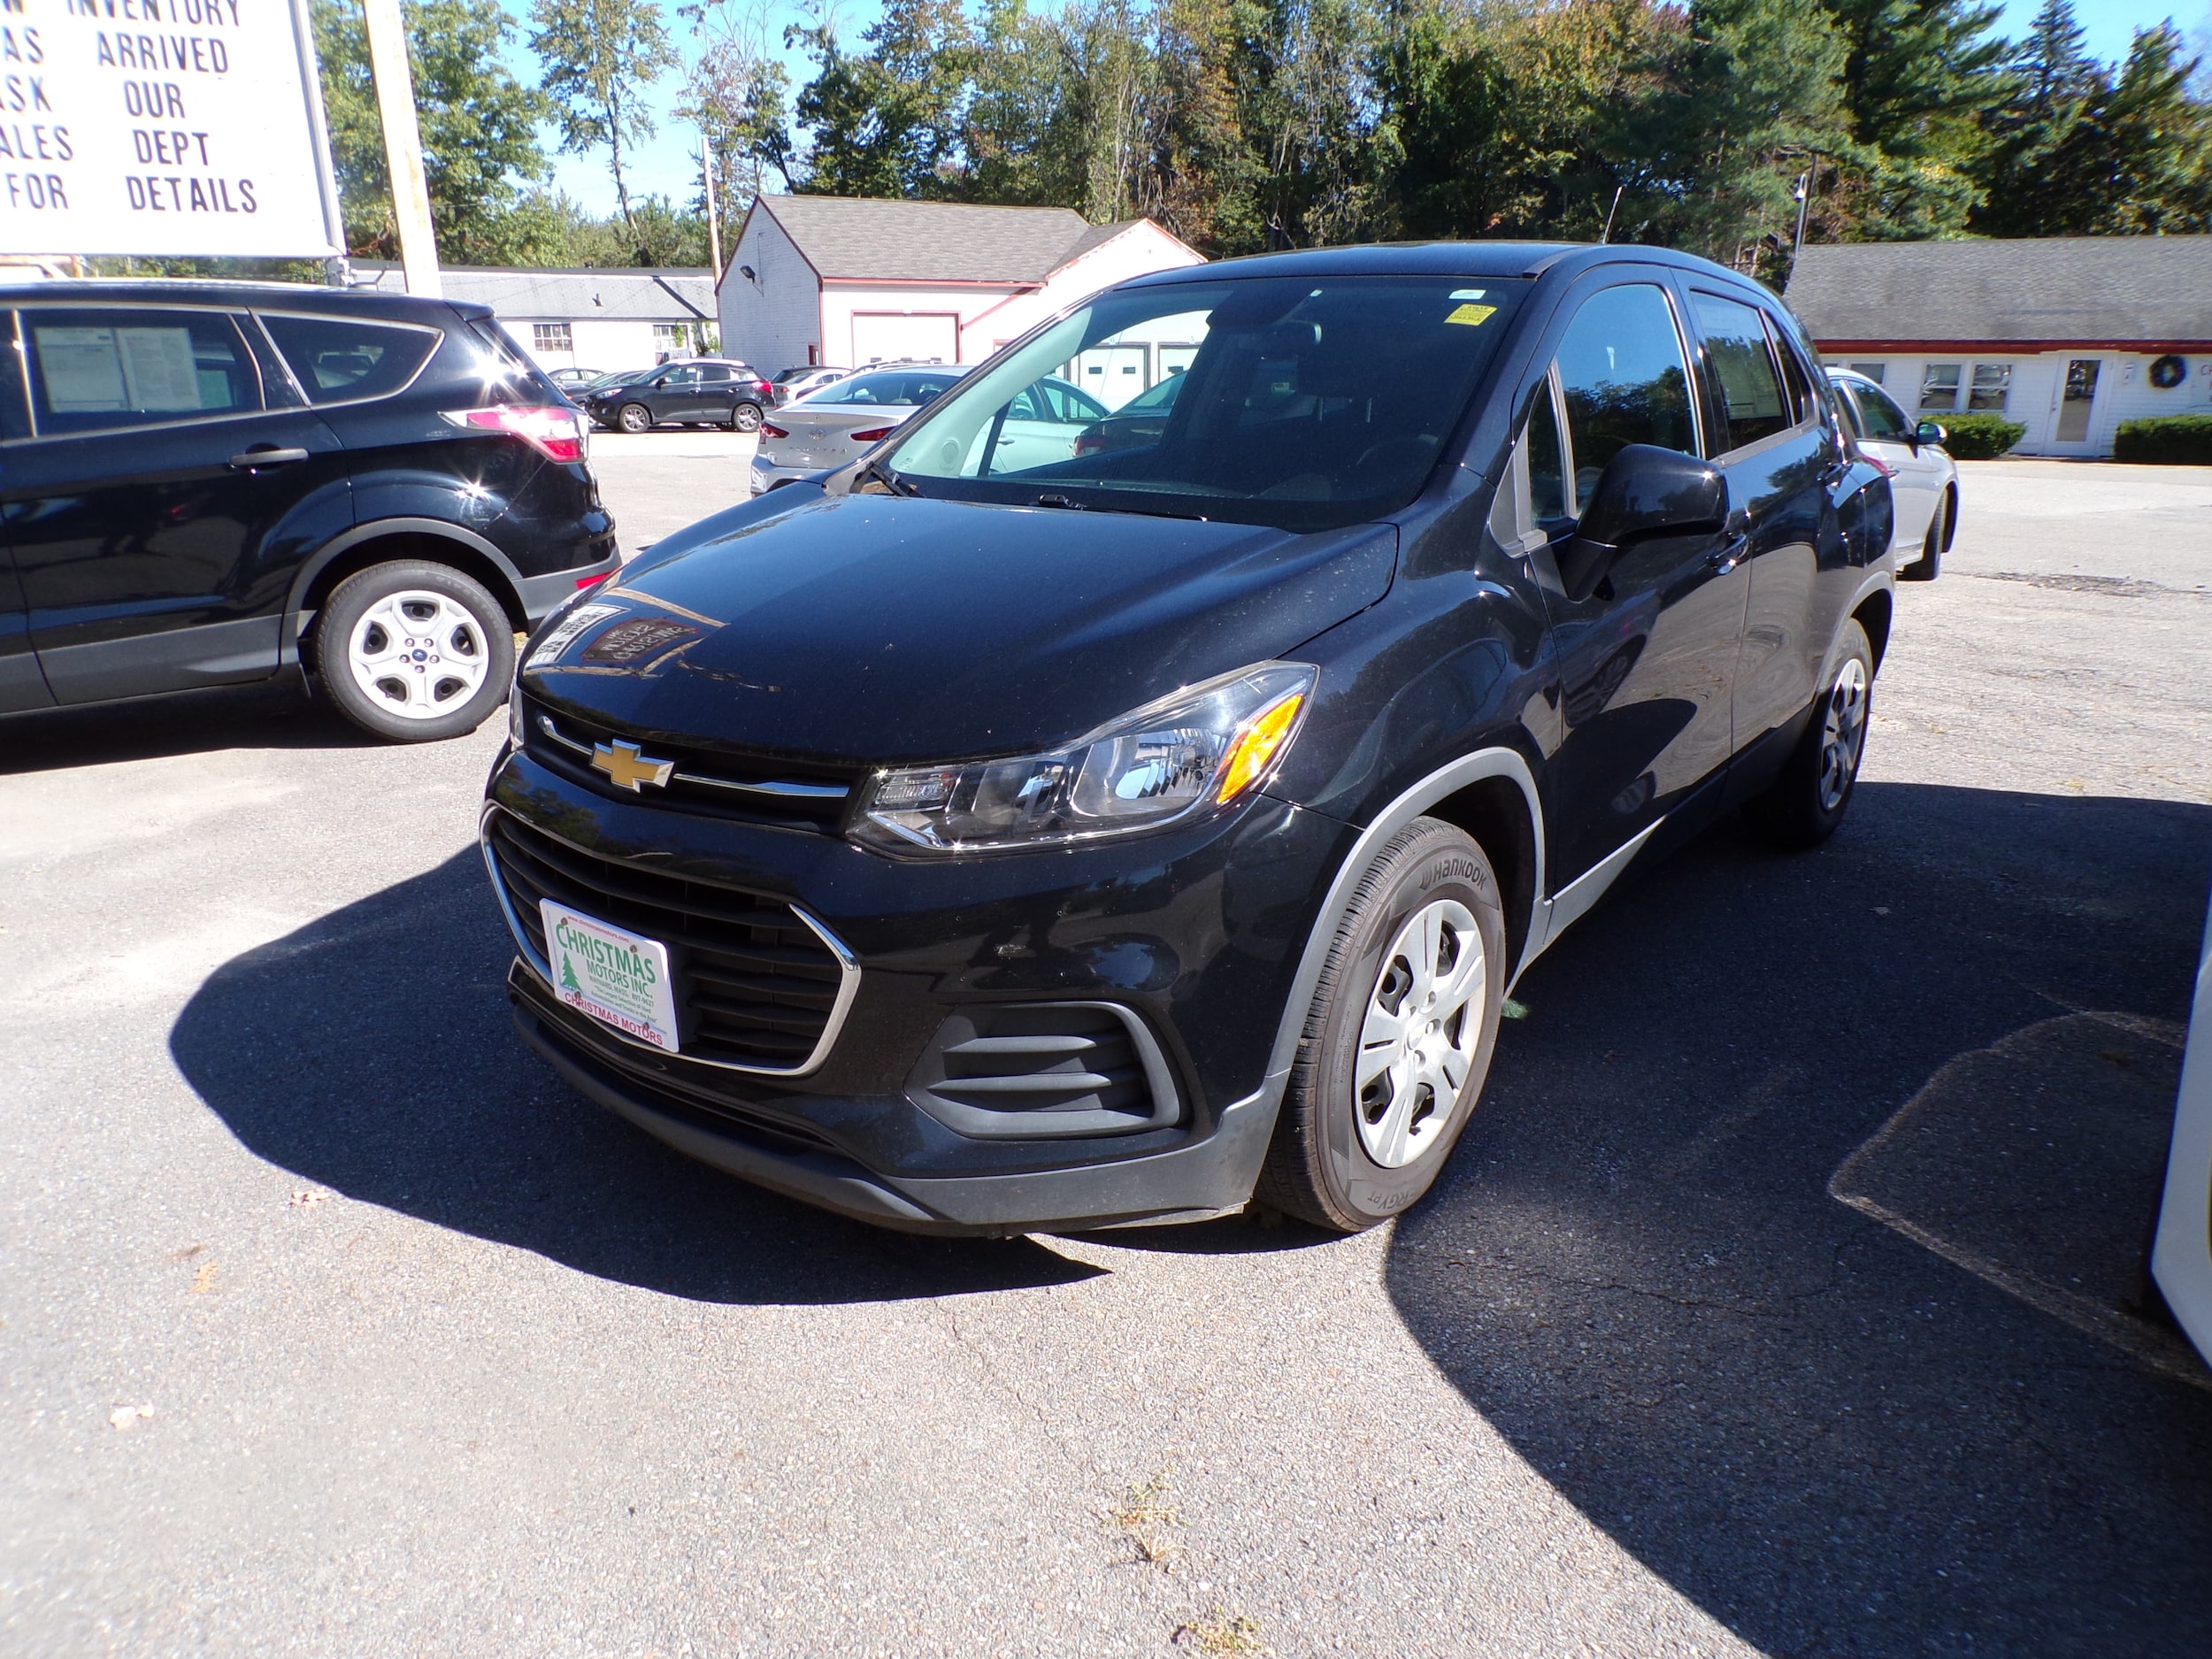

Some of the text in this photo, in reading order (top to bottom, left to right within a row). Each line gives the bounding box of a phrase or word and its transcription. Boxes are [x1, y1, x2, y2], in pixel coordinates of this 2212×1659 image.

[97, 31, 229, 73] ARRIVED
[0, 73, 186, 119] SK OUR
[132, 129, 210, 166] DEPT
[4, 172, 257, 213] FOR DETAILS
[556, 923, 657, 984] CHRISTMAS
[586, 959, 653, 999] MOTORS INC.
[565, 992, 664, 1045] CHRISTMAS MOTORS
